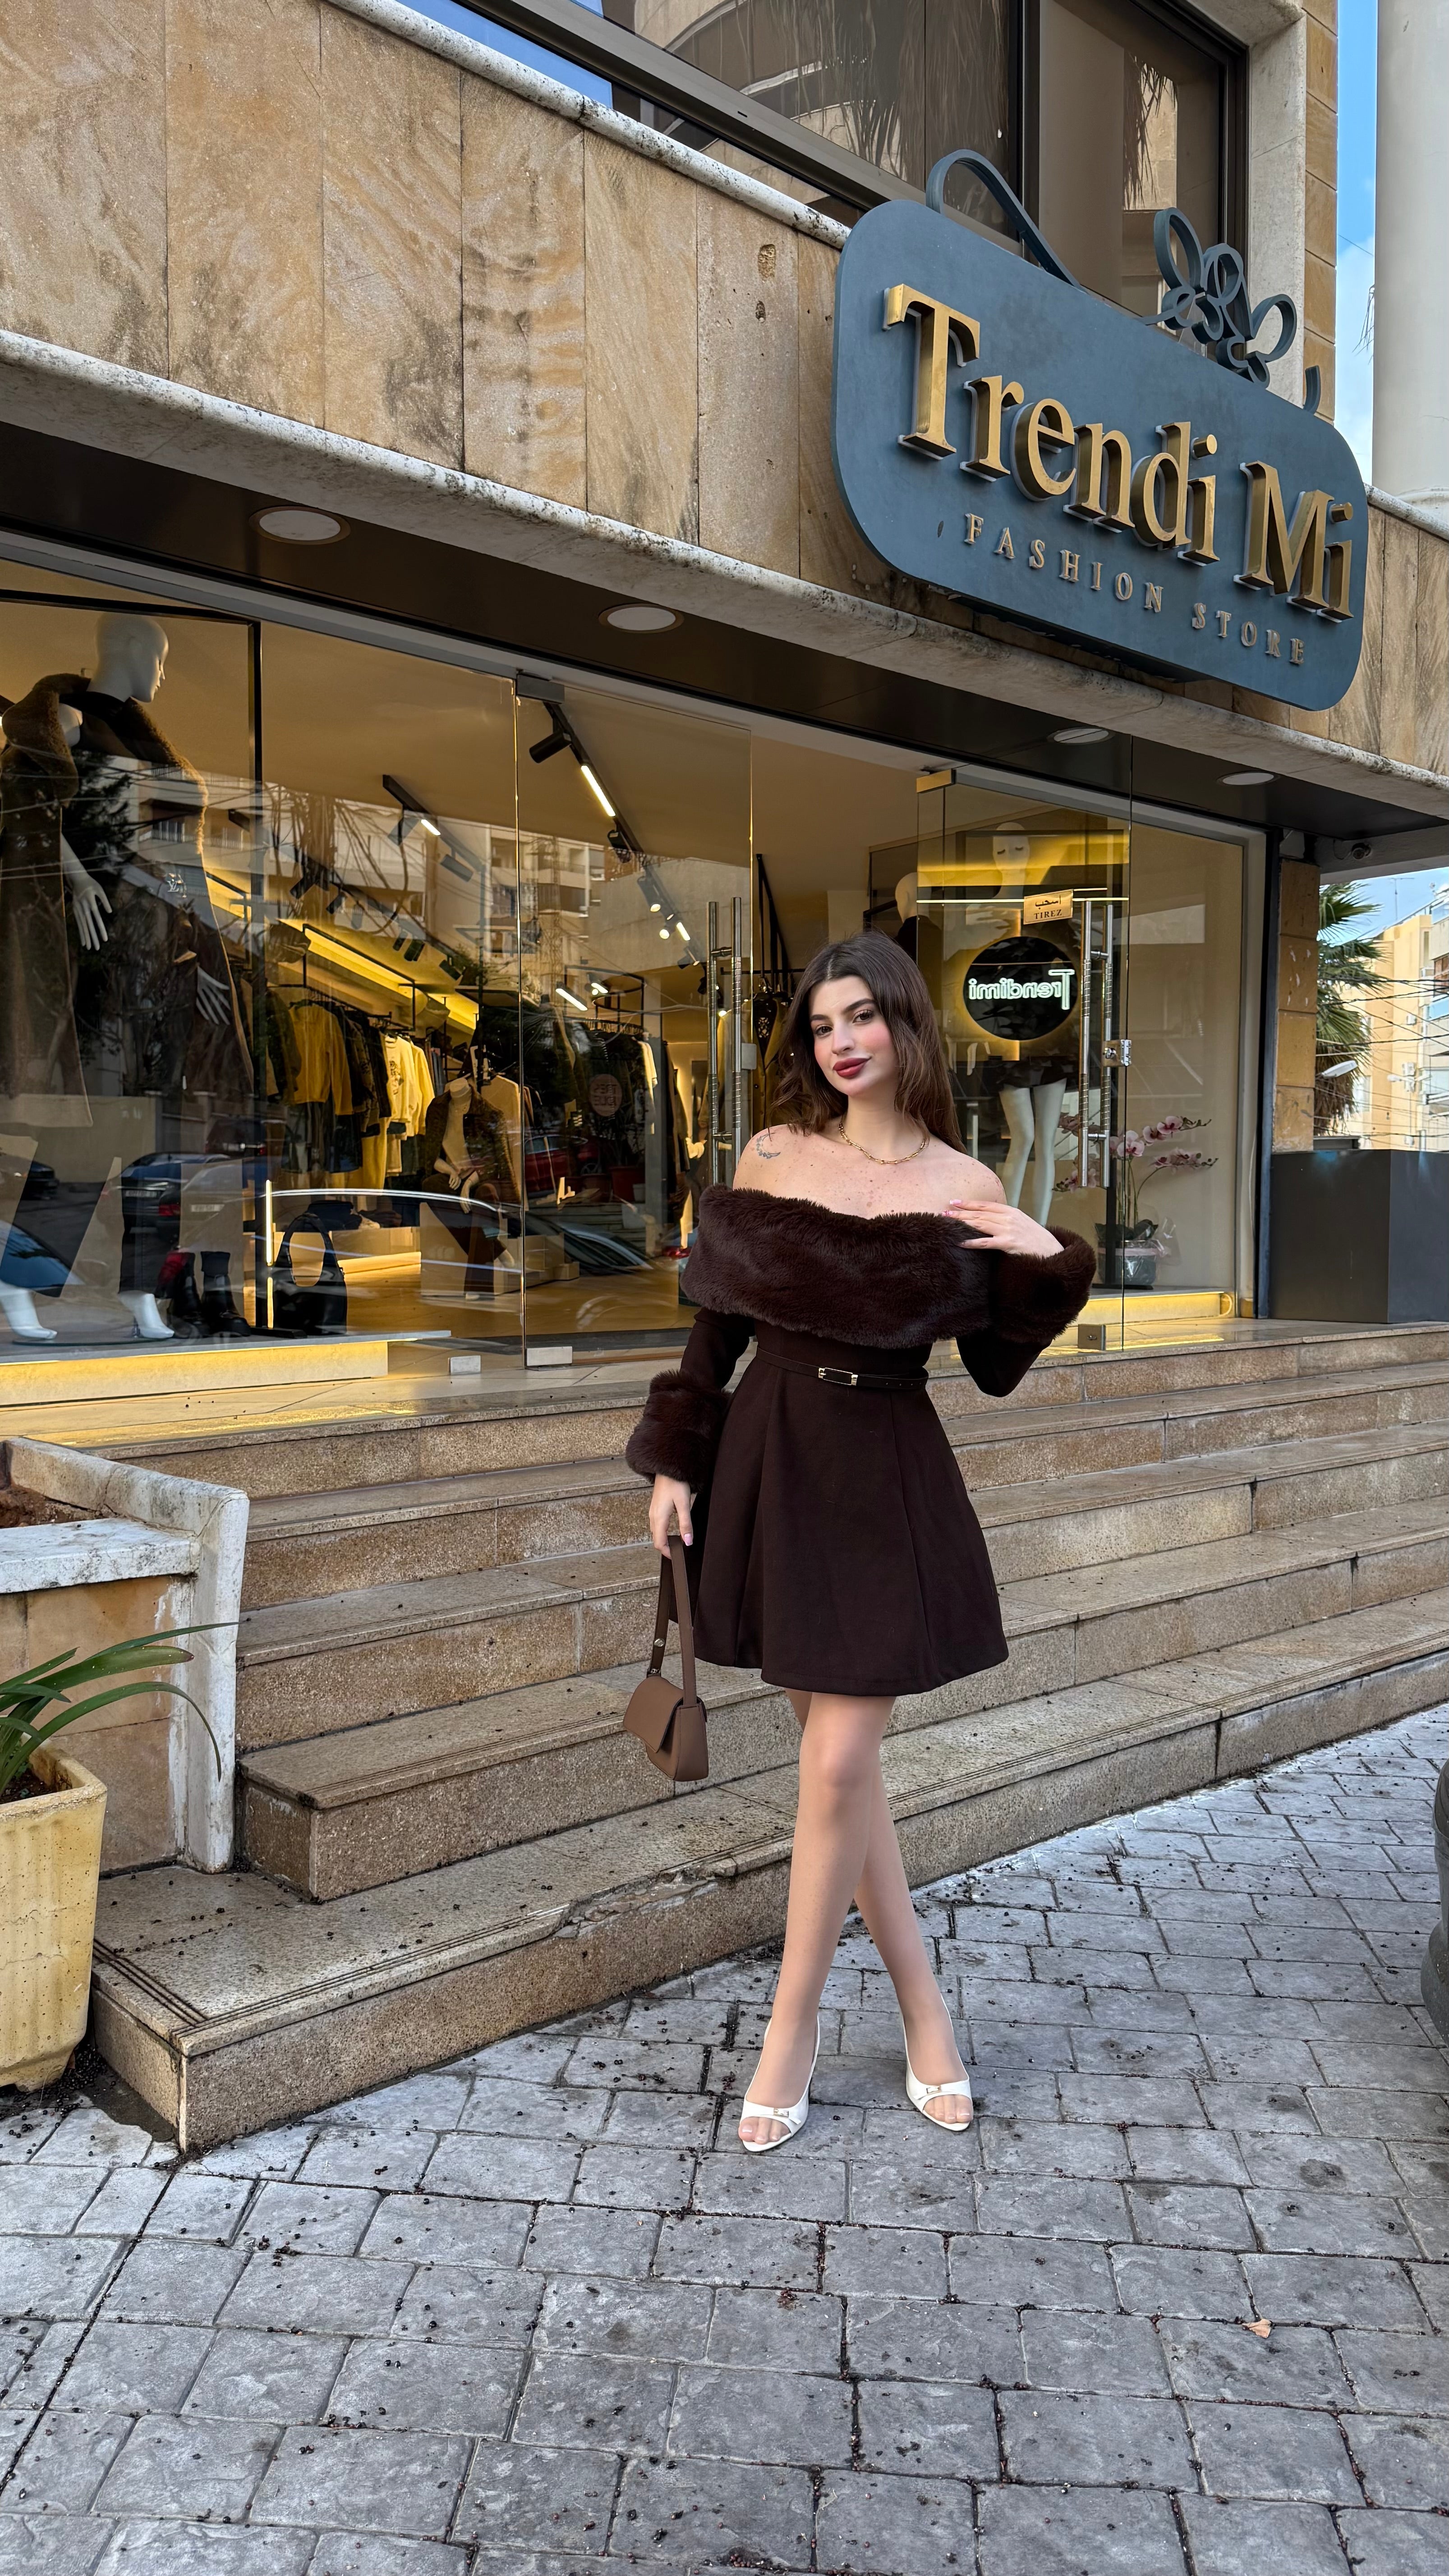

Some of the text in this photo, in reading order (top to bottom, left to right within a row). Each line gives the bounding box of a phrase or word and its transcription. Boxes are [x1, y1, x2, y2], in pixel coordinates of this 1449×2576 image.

[882, 284, 1354, 623] Trendi Mi
[964, 512, 1305, 665] FASHION STORE
[1033, 909, 1062, 920] TIREZ
